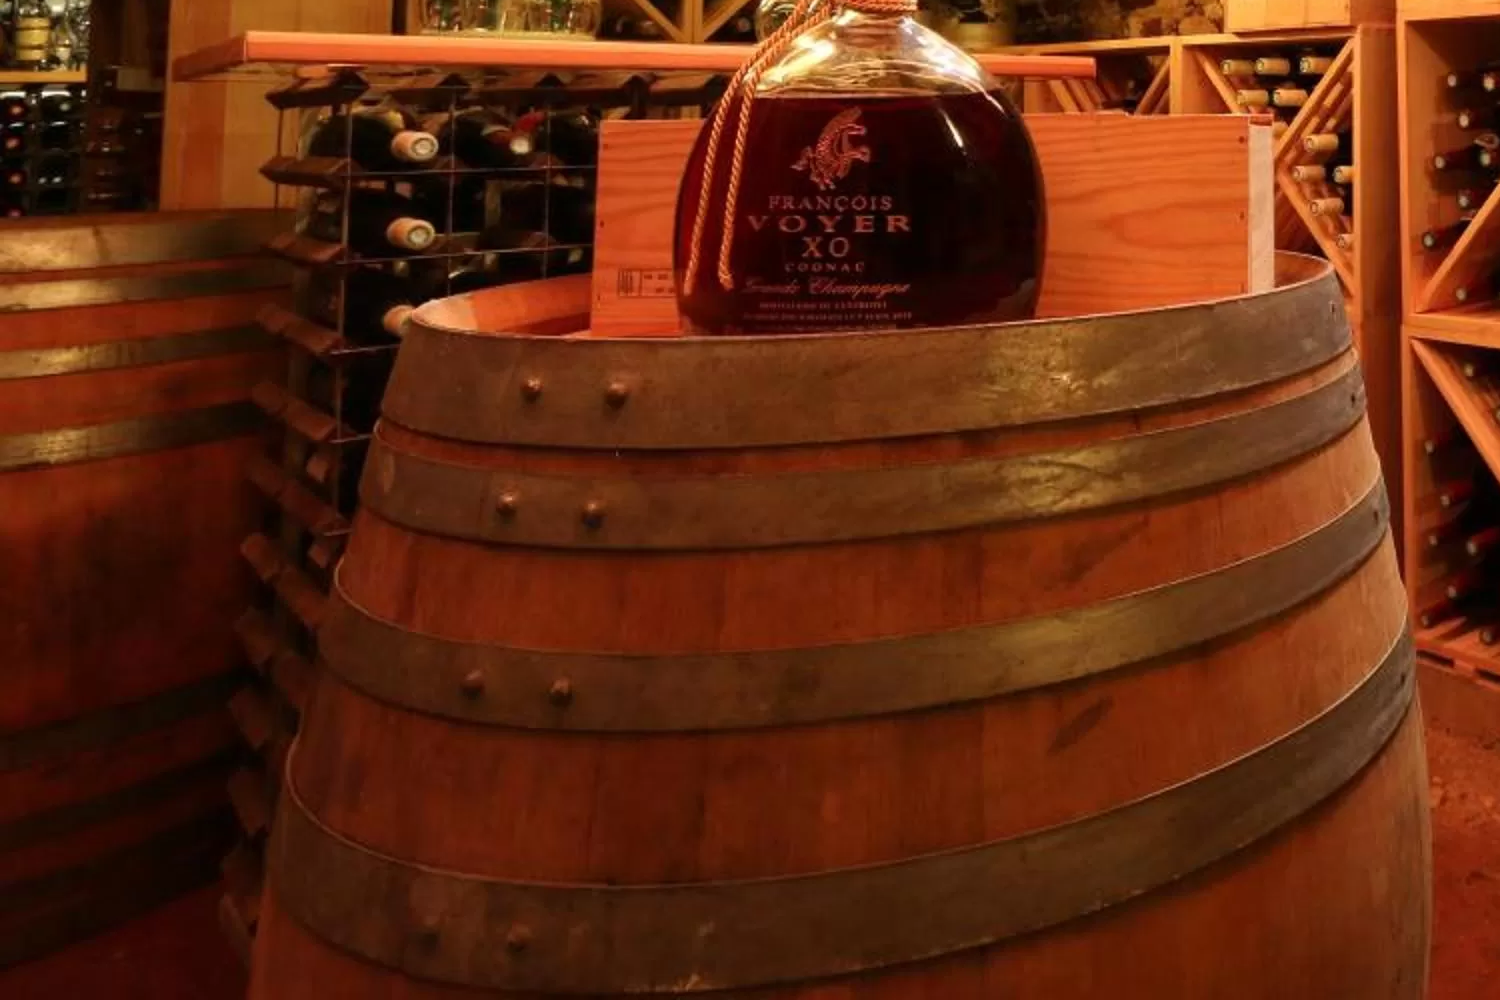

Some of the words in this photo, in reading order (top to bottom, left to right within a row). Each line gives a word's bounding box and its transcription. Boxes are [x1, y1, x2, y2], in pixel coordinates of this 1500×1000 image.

[767, 195, 893, 213] FRANÇOIS
[747, 215, 912, 233] VOYER
[801, 236, 850, 258] XO
[784, 262, 866, 273] COGNAC
[808, 276, 912, 299] Champagne
